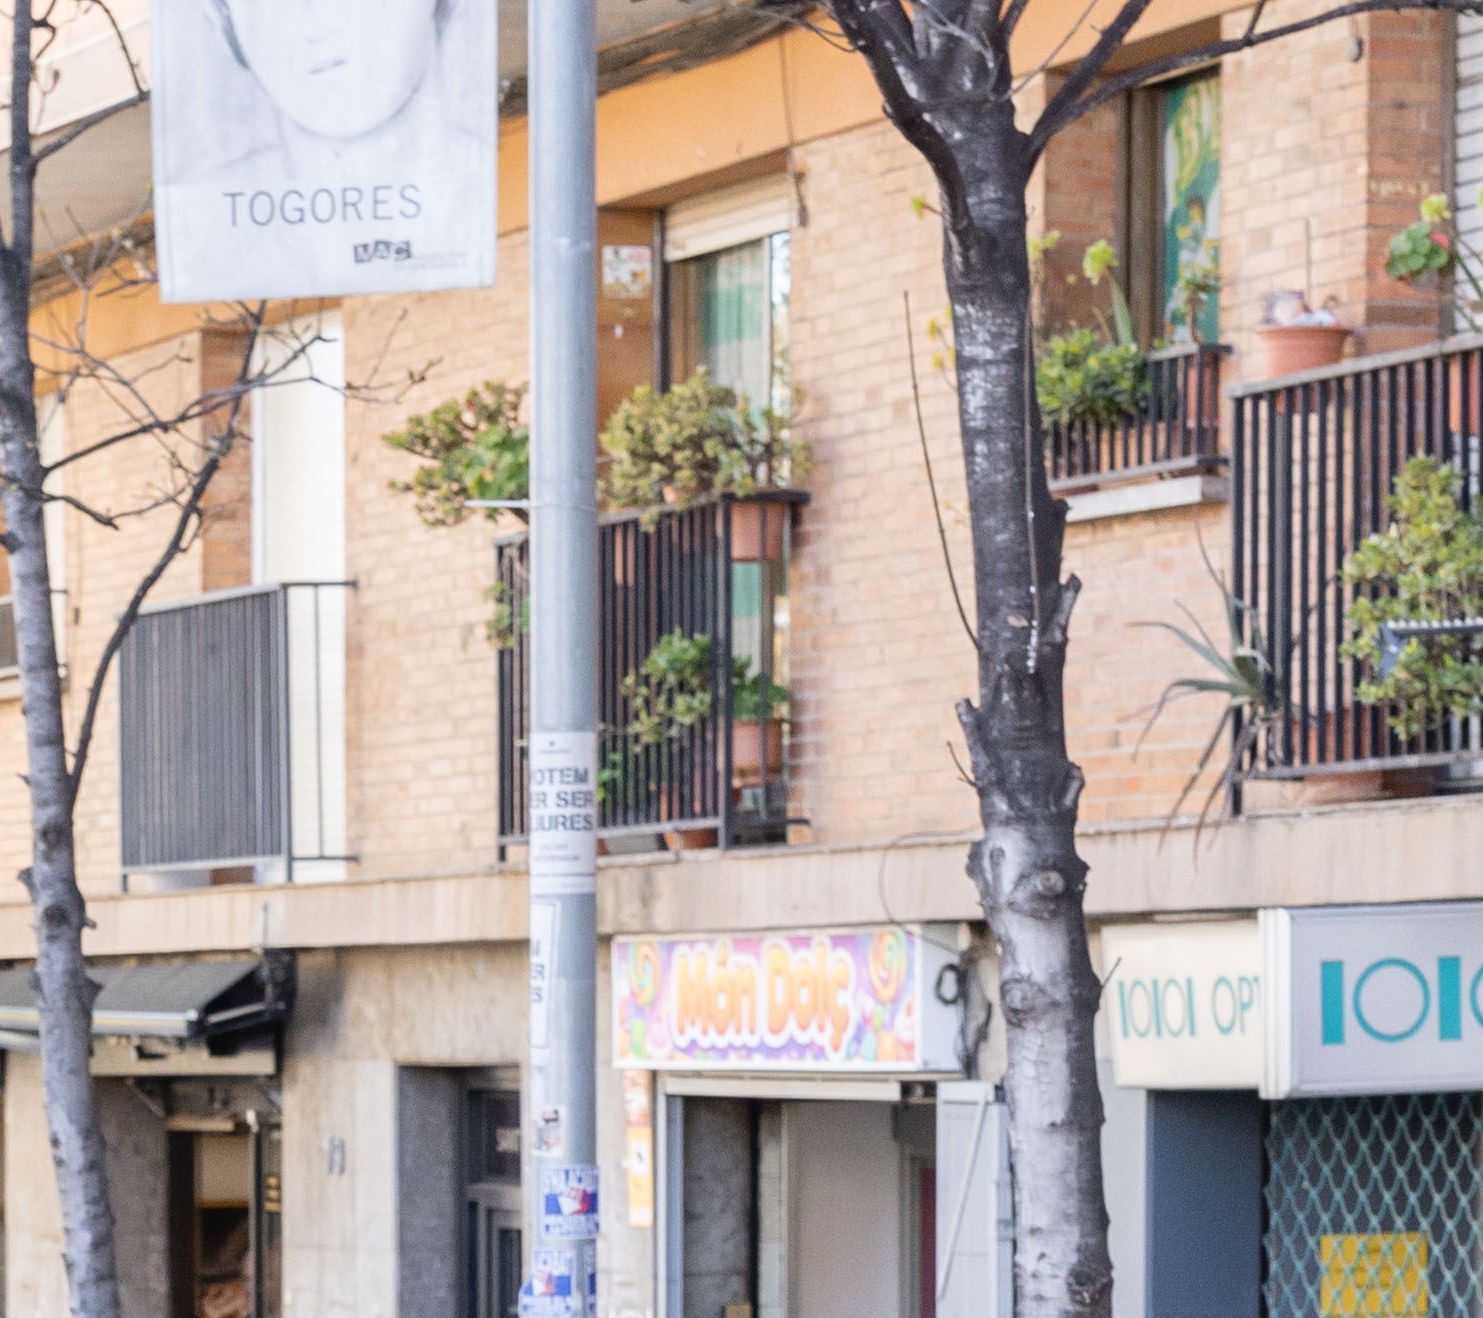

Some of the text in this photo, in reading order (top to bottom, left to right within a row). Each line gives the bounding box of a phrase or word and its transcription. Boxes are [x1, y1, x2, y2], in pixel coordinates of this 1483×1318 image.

[222, 184, 422, 227] TOGORES
[532, 767, 589, 786] OTEM
[675, 936, 756, 1037] Món
[765, 940, 851, 1055] Dolç
